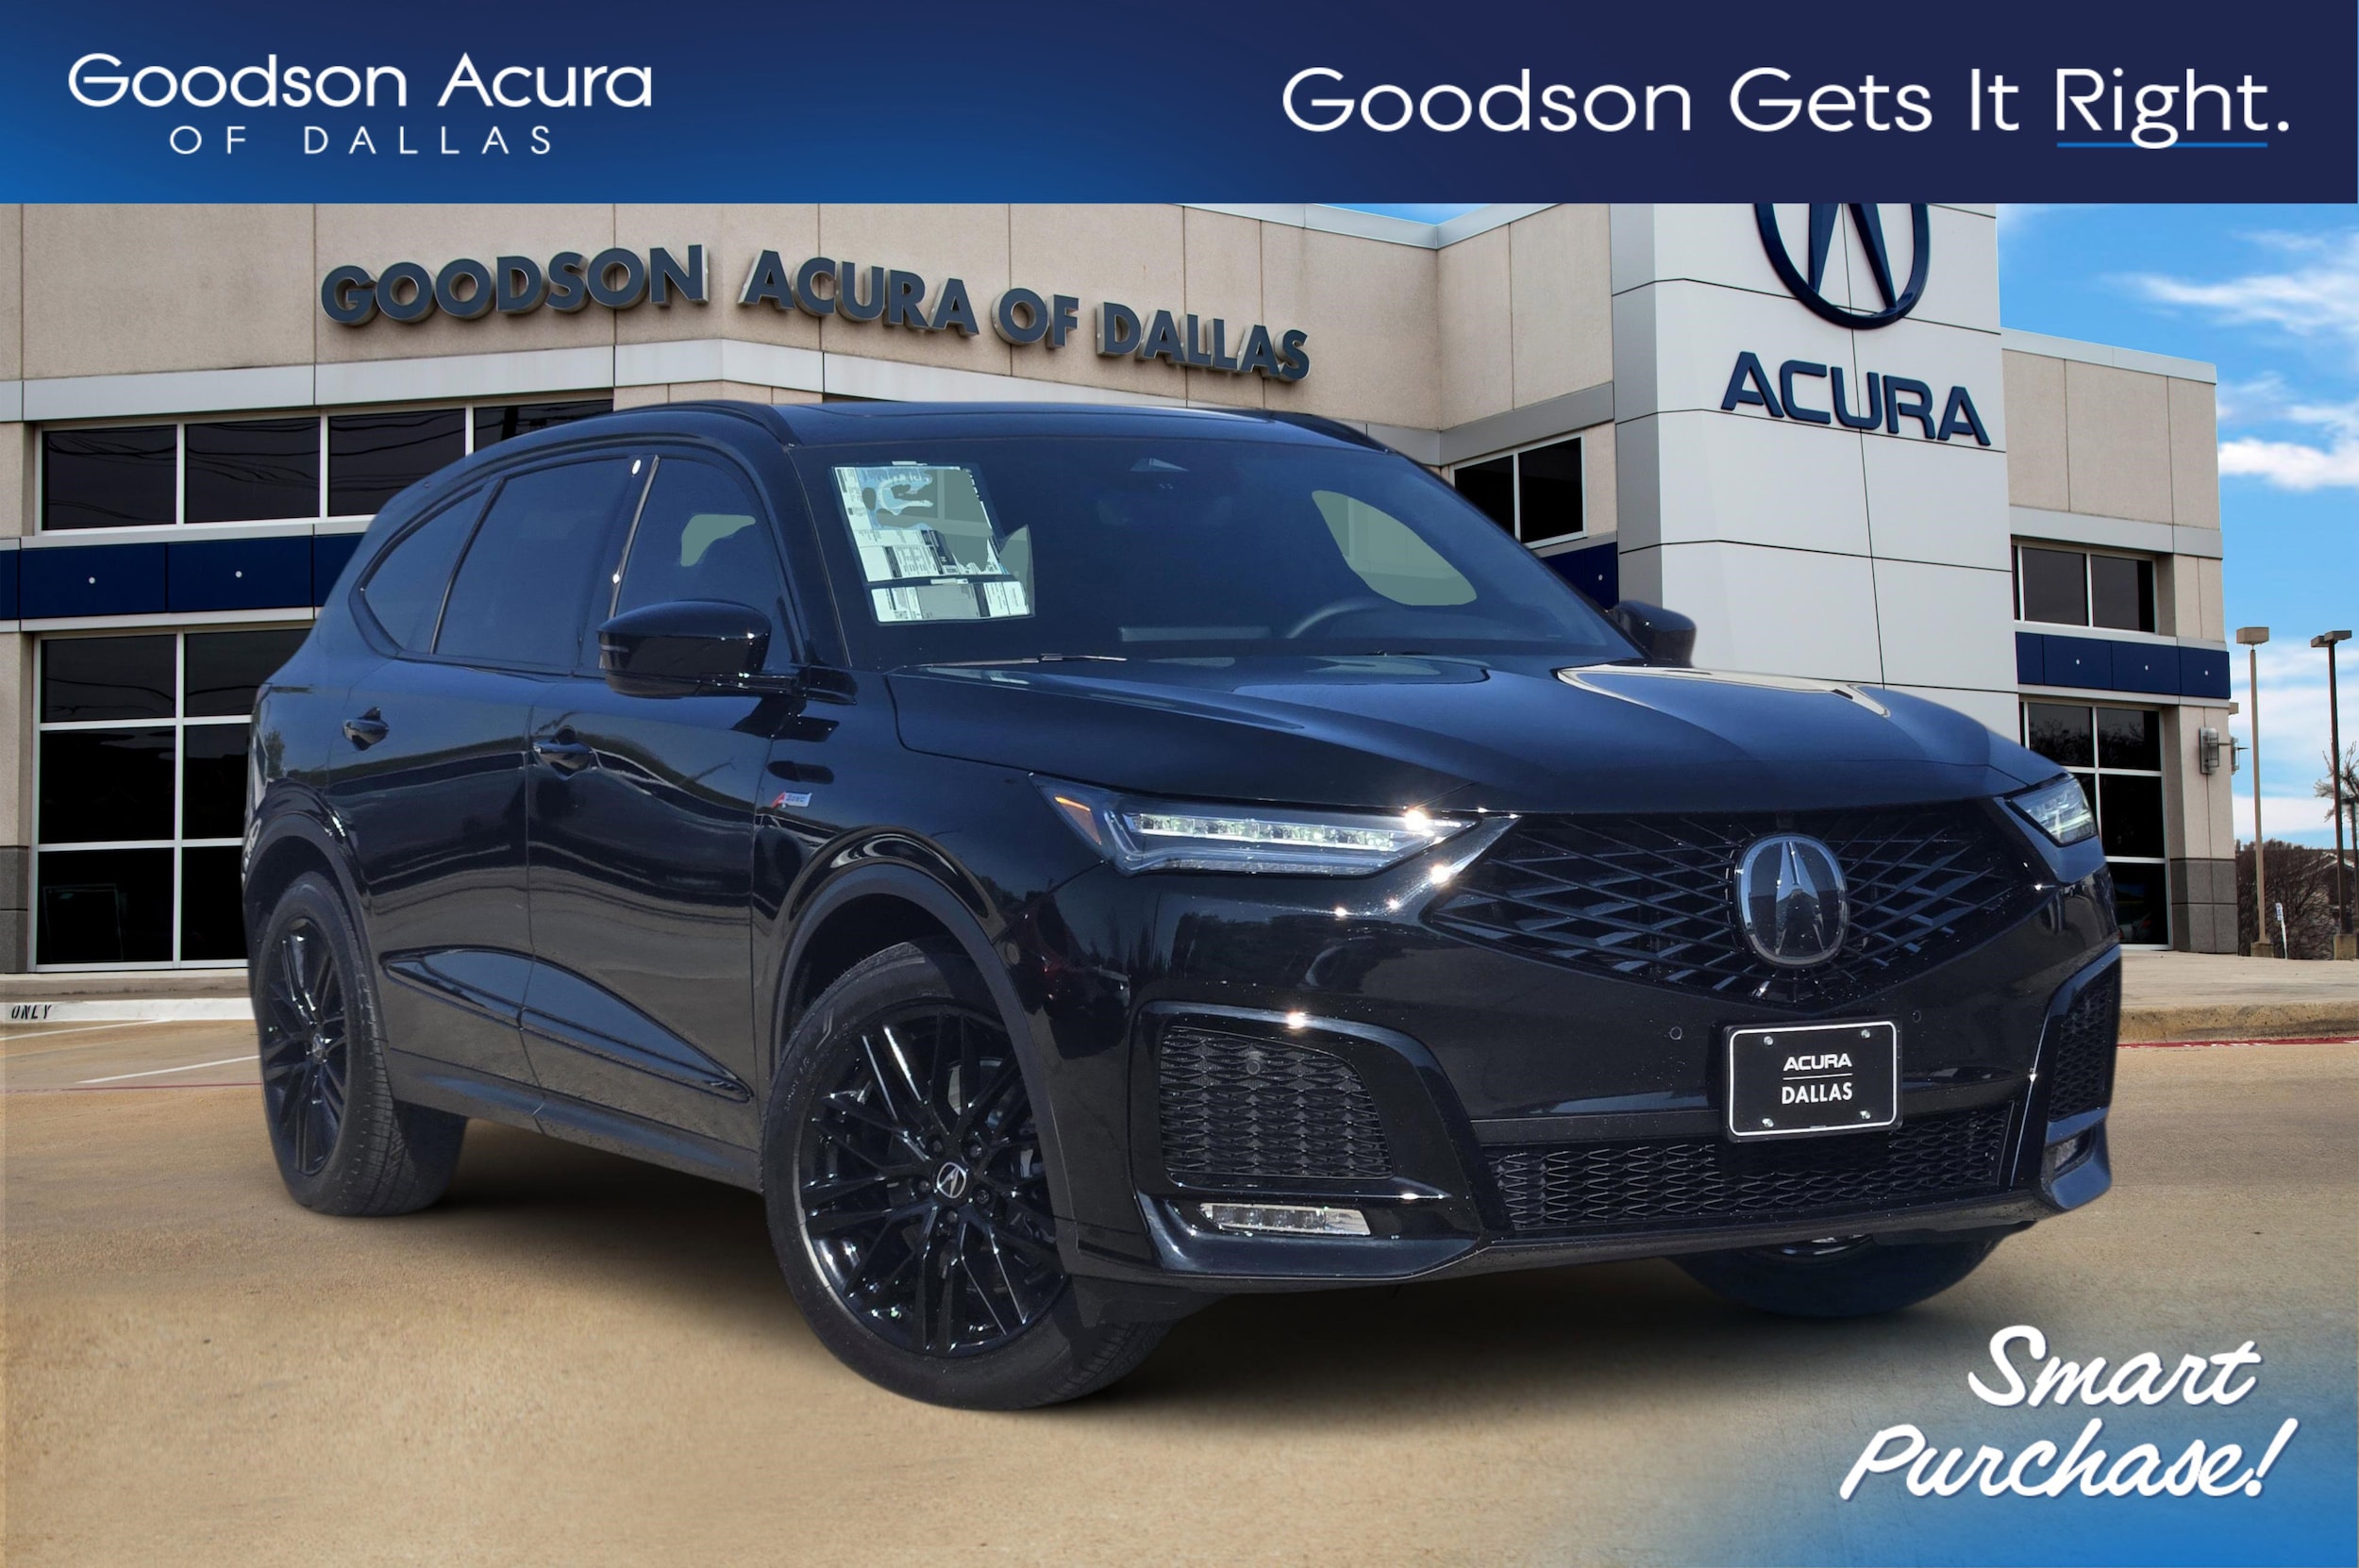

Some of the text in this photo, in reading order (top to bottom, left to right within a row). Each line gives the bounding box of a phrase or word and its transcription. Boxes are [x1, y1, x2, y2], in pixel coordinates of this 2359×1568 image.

[321, 244, 1311, 381] GOODSON ACURA OF DALLAS
[1720, 351, 1991, 446] ACURA
[11, 1004, 52, 1020] ONLY
[1782, 1053, 1852, 1072] ACURA
[1782, 1082, 1853, 1105] DALLAS
